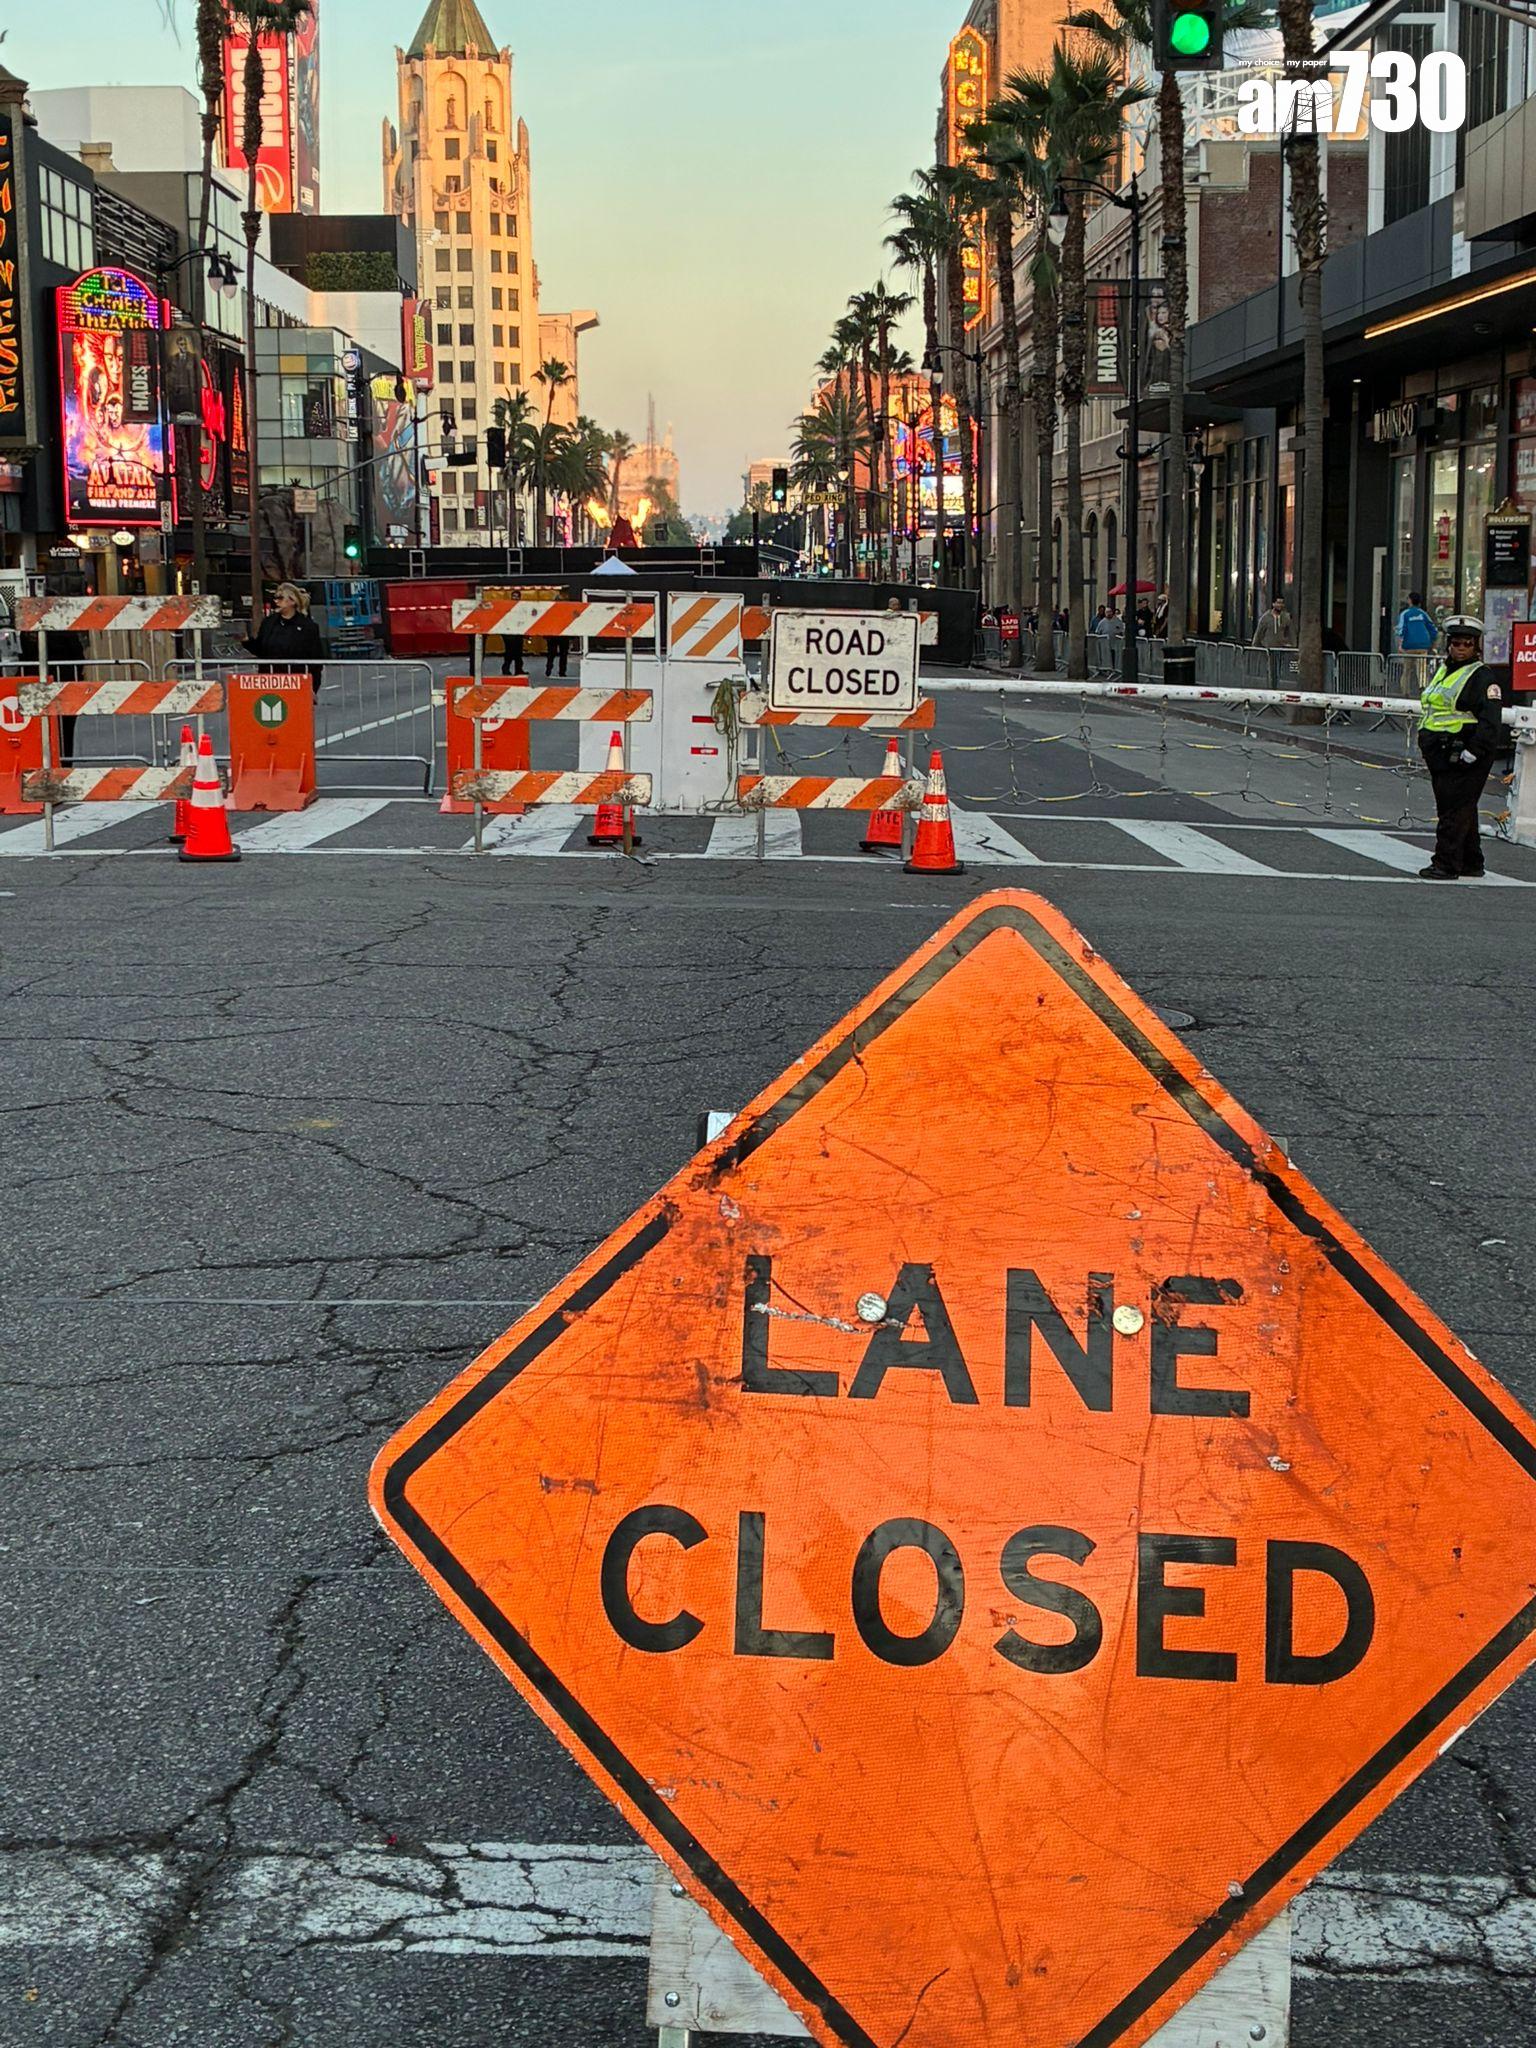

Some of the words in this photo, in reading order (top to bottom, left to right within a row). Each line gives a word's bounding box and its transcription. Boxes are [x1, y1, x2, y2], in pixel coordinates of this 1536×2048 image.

[101, 274, 129, 292] TCL
[82, 292, 149, 314] CHINESE
[87, 461, 156, 486] AVATAR
[88, 486, 110, 498] FIRE
[113, 487, 134, 499] AND
[136, 488, 157, 499] ASH
[804, 494, 821, 502] PED
[805, 628, 886, 656] ROAD
[241, 676, 299, 689] MERIDIAN
[788, 667, 901, 697] CLOSED
[741, 1254, 1251, 1419] LANE
[600, 1504, 1375, 1686] CLOSED
